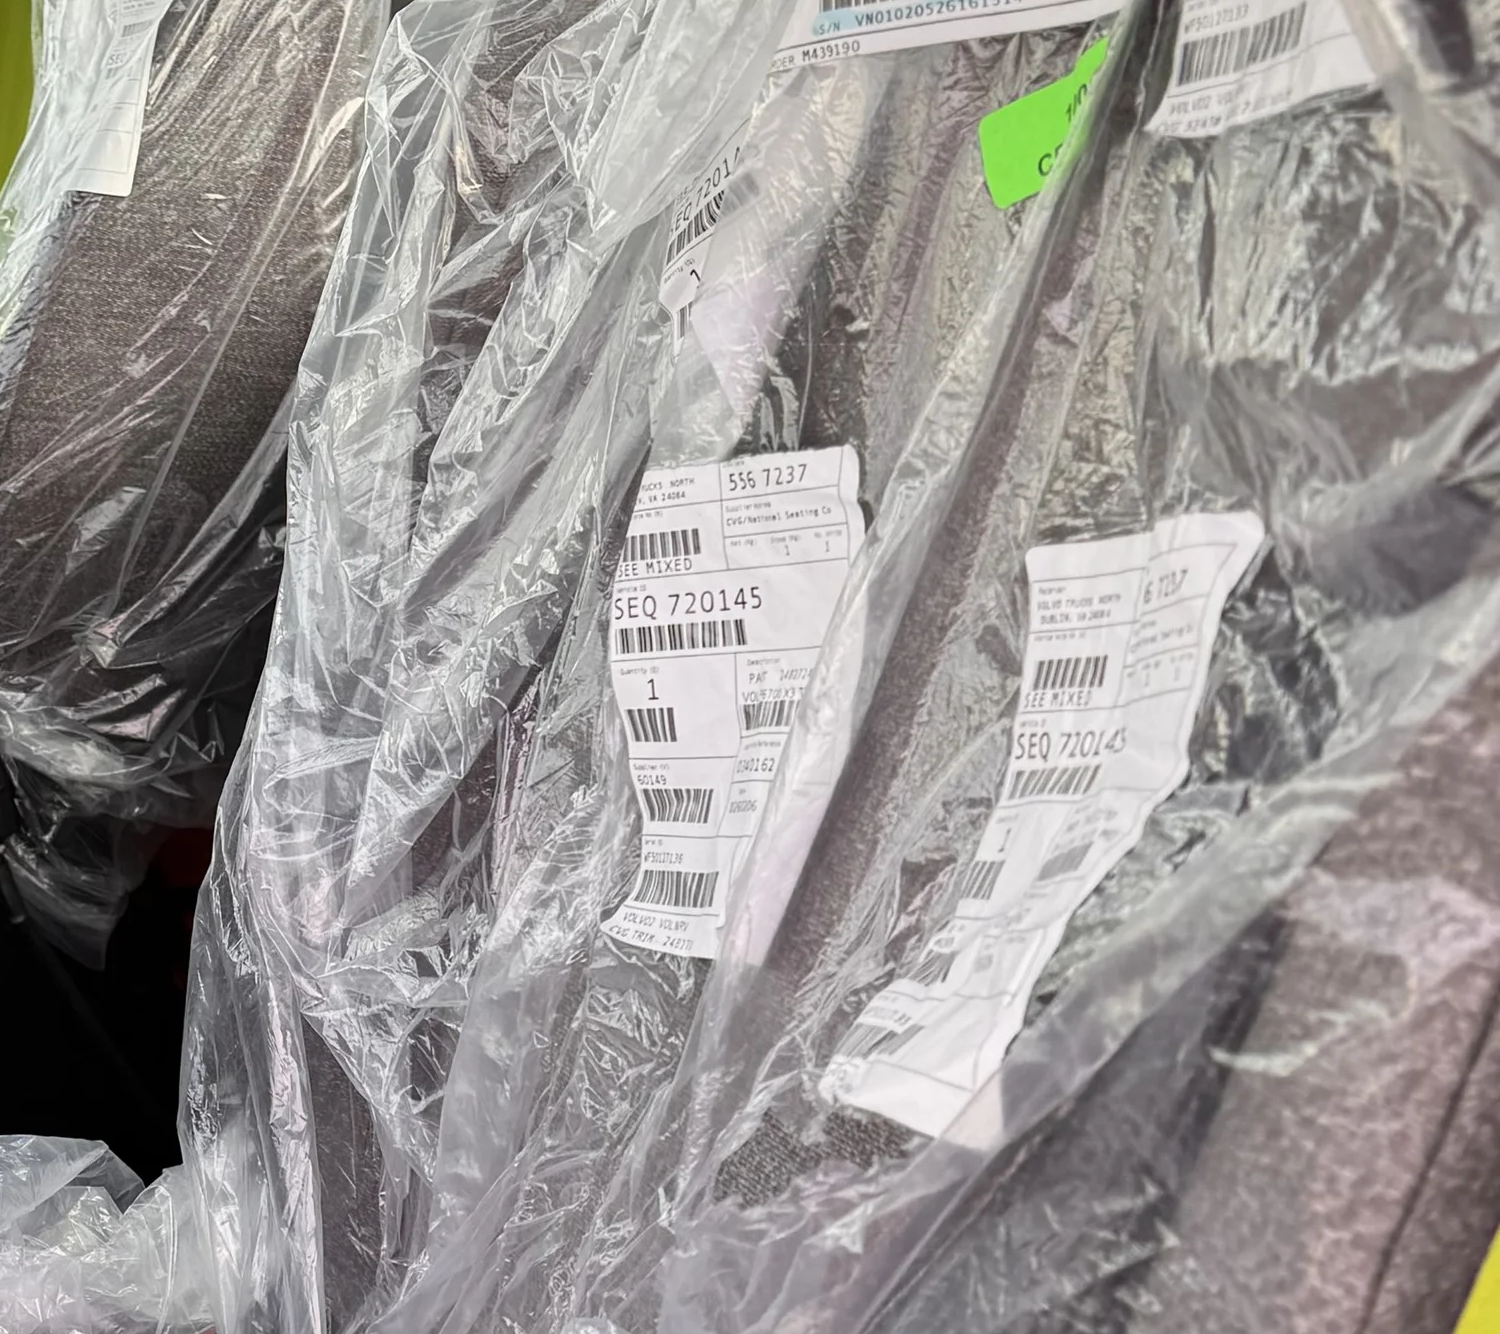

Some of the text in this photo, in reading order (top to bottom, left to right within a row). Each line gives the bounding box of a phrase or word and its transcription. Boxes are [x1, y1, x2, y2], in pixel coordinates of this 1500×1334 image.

[817, 20, 842, 37] S/N
[802, 40, 861, 63] M439190
[729, 463, 808, 492] 556 7237
[618, 557, 693, 578] SEE MIXED
[614, 586, 763, 621] SEQ 720145
[647, 678, 660, 701] 1
[1024, 690, 1046, 709] SEE
[1014, 731, 1052, 764] SEQ
